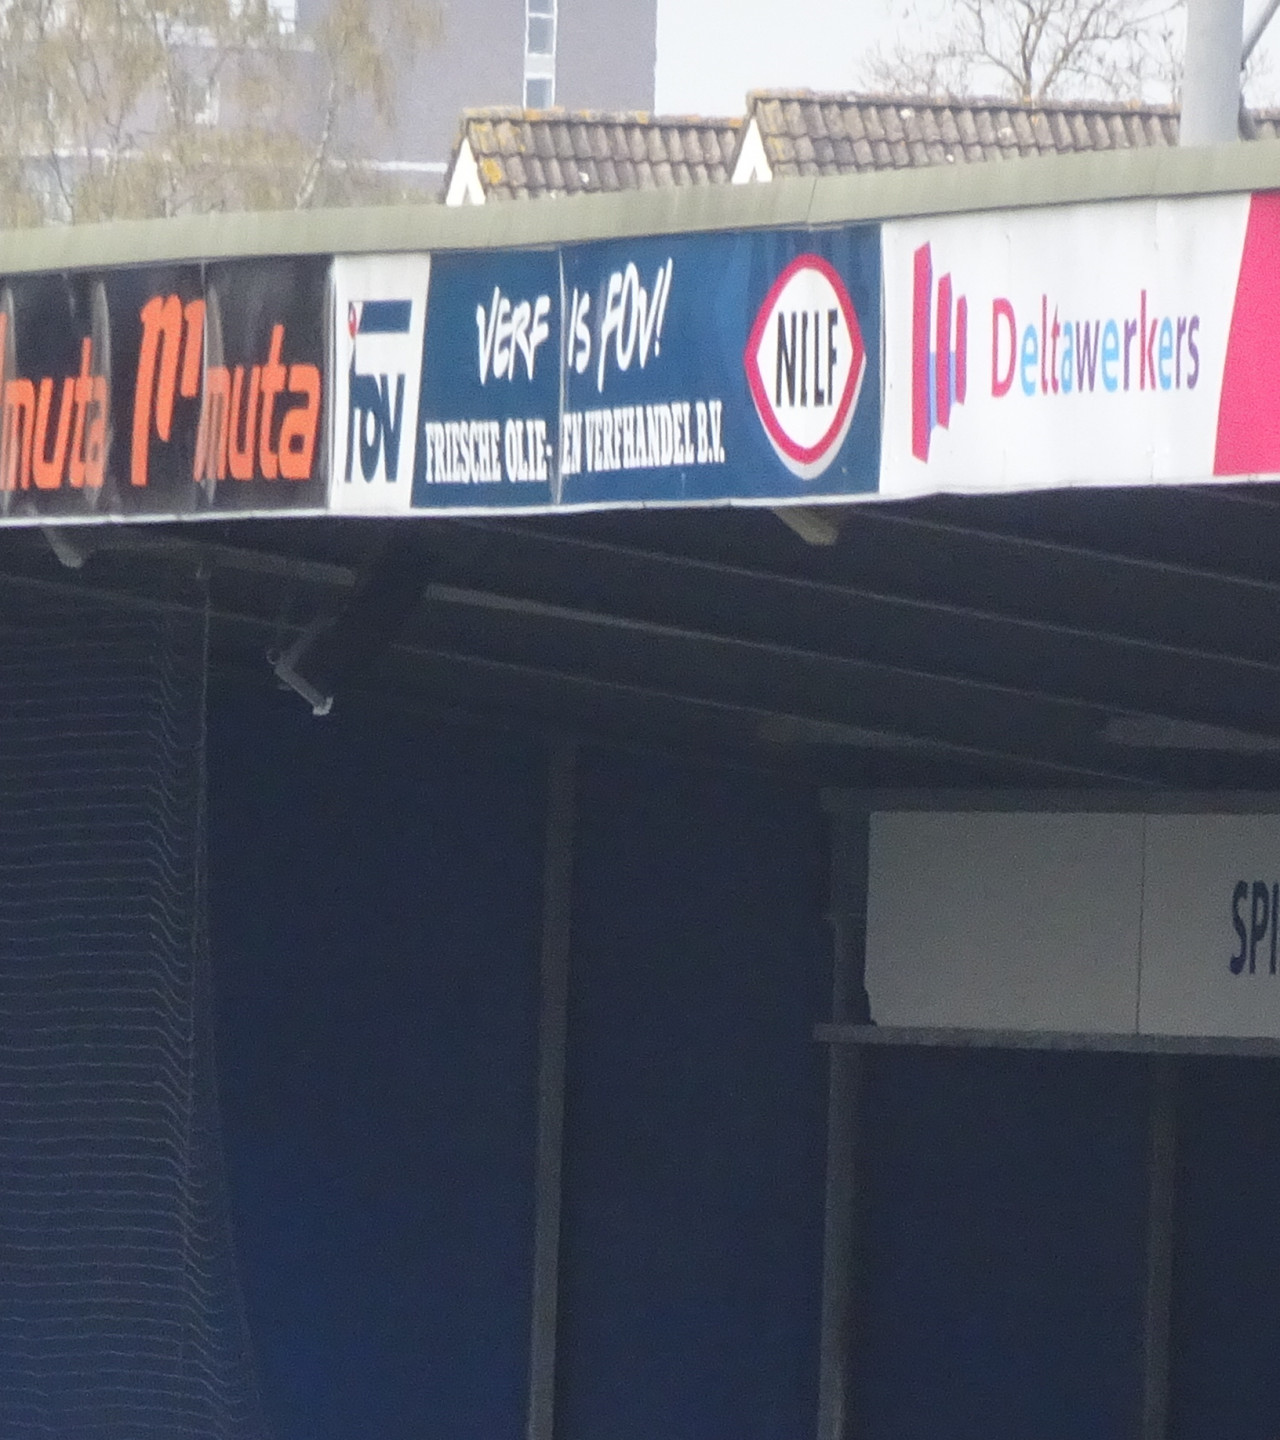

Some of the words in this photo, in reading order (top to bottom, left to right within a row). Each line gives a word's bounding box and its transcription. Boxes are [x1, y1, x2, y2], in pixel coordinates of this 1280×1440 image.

[476, 285, 551, 386] VERF
[775, 308, 839, 409] NILF
[990, 289, 1201, 398] Deltawerkers
[425, 420, 502, 483] FRIESCHE
[504, 418, 553, 483] OLIE-
[562, 411, 583, 475] EN
[585, 402, 694, 472] VERFHANDEL
[696, 398, 725, 463] B.V.
